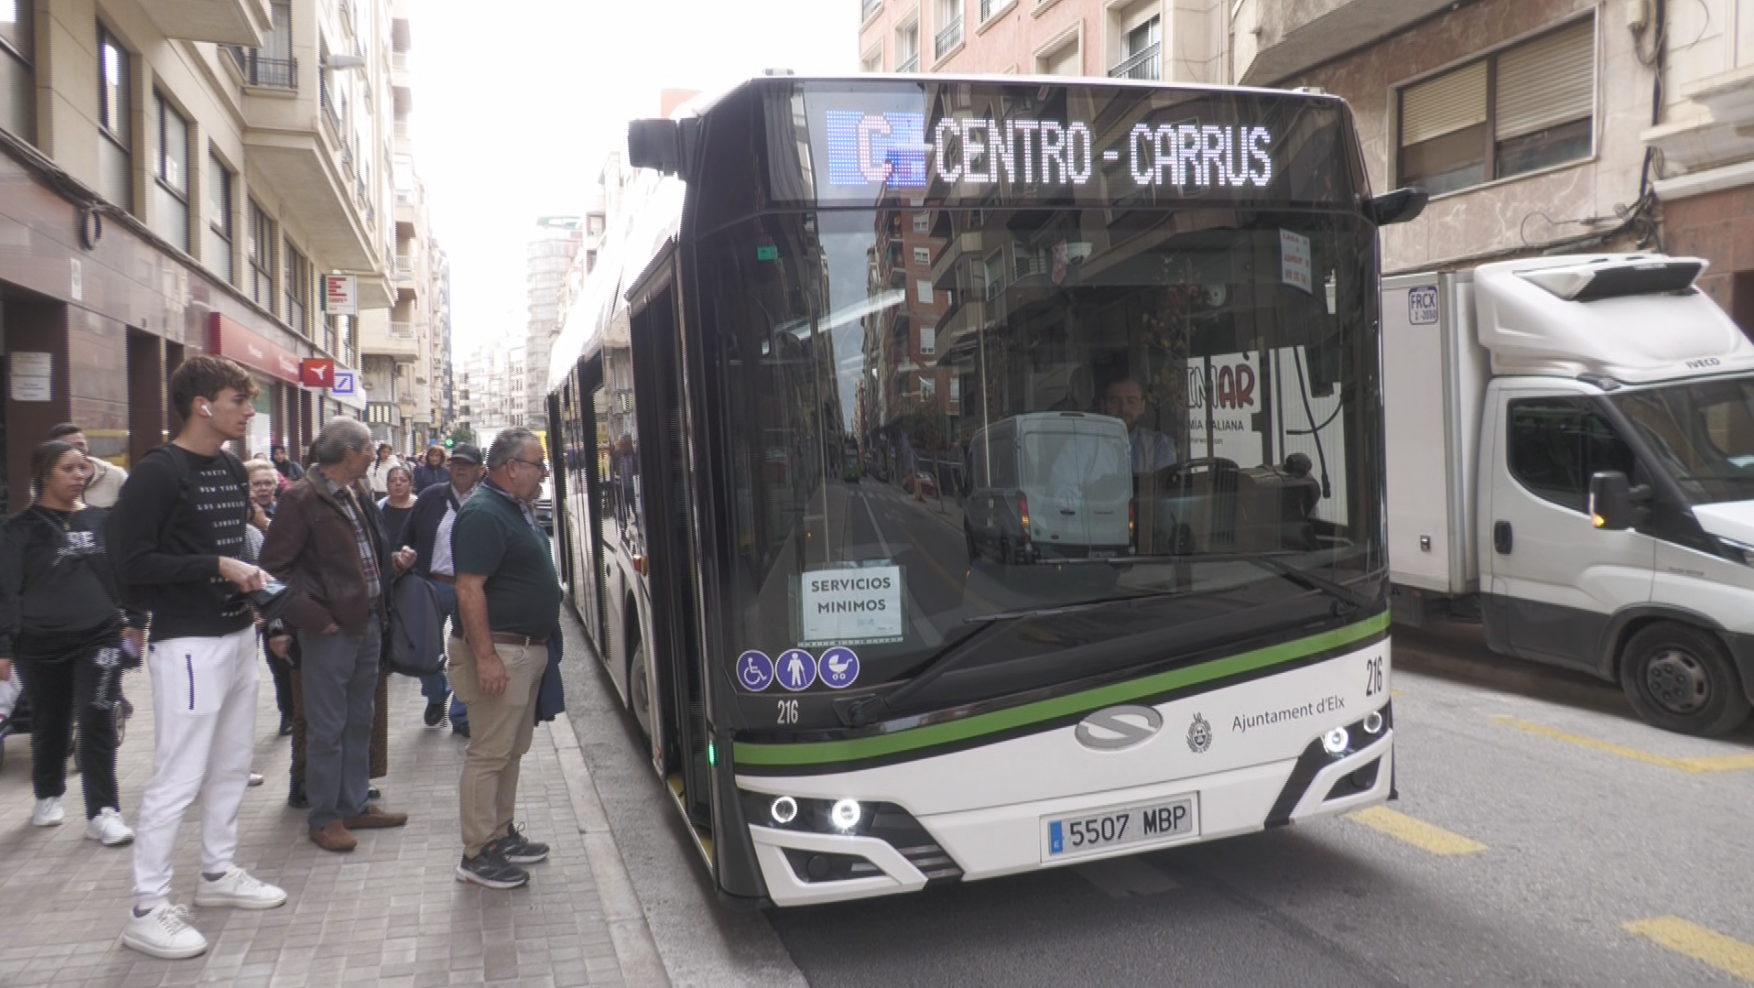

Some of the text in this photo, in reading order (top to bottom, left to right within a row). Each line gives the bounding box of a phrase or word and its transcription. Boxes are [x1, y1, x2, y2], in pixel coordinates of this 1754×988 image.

[935, 117, 1091, 184] CENTRO
[1130, 122, 1272, 187] CARRUS
[1411, 293, 1436, 309] FRCX
[1686, 358, 1721, 369] IVECO
[1211, 419, 1245, 431] ALIANA
[216, 501, 246, 509] ANGELE
[811, 577, 891, 593] SERVICIOS
[817, 599, 886, 614] MINIMOS
[1365, 655, 1384, 698] 216
[777, 699, 799, 724] 216
[1232, 695, 1345, 732] Ajuntament d'Elx
[1069, 814, 1130, 846] 5507
[1143, 805, 1187, 836] MBP
